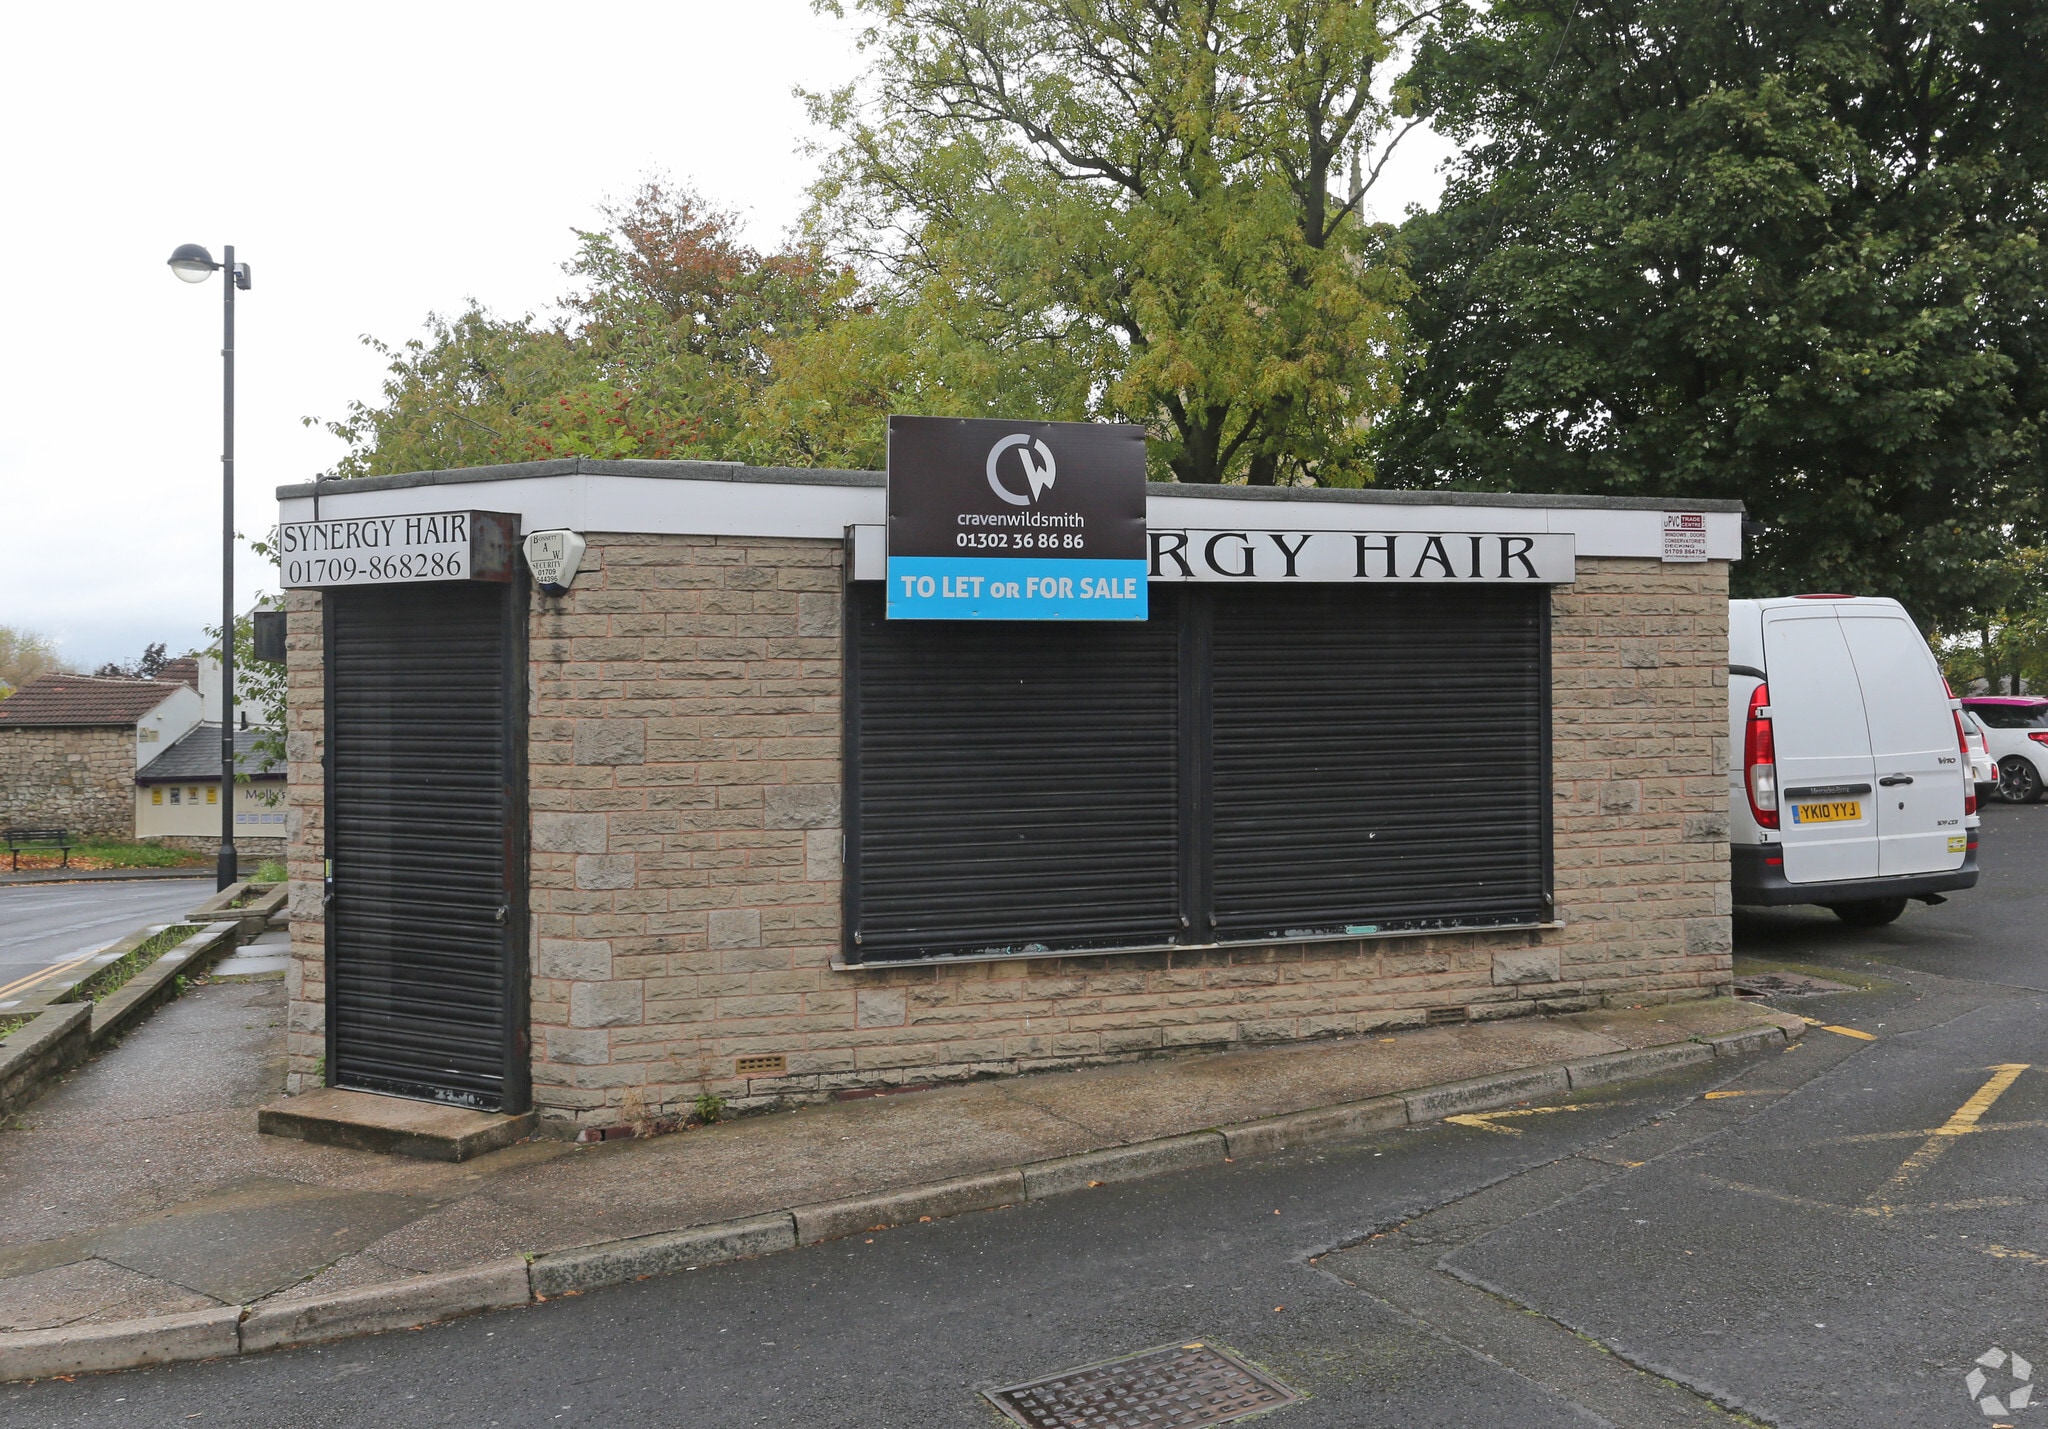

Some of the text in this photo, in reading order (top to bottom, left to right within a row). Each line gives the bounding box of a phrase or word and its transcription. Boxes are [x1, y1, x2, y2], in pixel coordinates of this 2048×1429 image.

[957, 511, 1085, 528] cravenwildsmith
[285, 515, 467, 552] SYNERGY HAIR
[956, 532, 1084, 549] 01302 36 86 86
[543, 542, 548, 552] A
[552, 550, 560, 559] W
[1147, 532, 1541, 579] RGY HAIR
[289, 551, 461, 584] 01709-868286
[532, 561, 561, 569] SECURITY
[901, 575, 936, 598] TO
[942, 576, 985, 598] LET
[1026, 577, 1074, 599] FOR
[1080, 577, 1137, 599] SALE
[245, 788, 286, 799] Mll's
[1803, 803, 1830, 820] YK10
